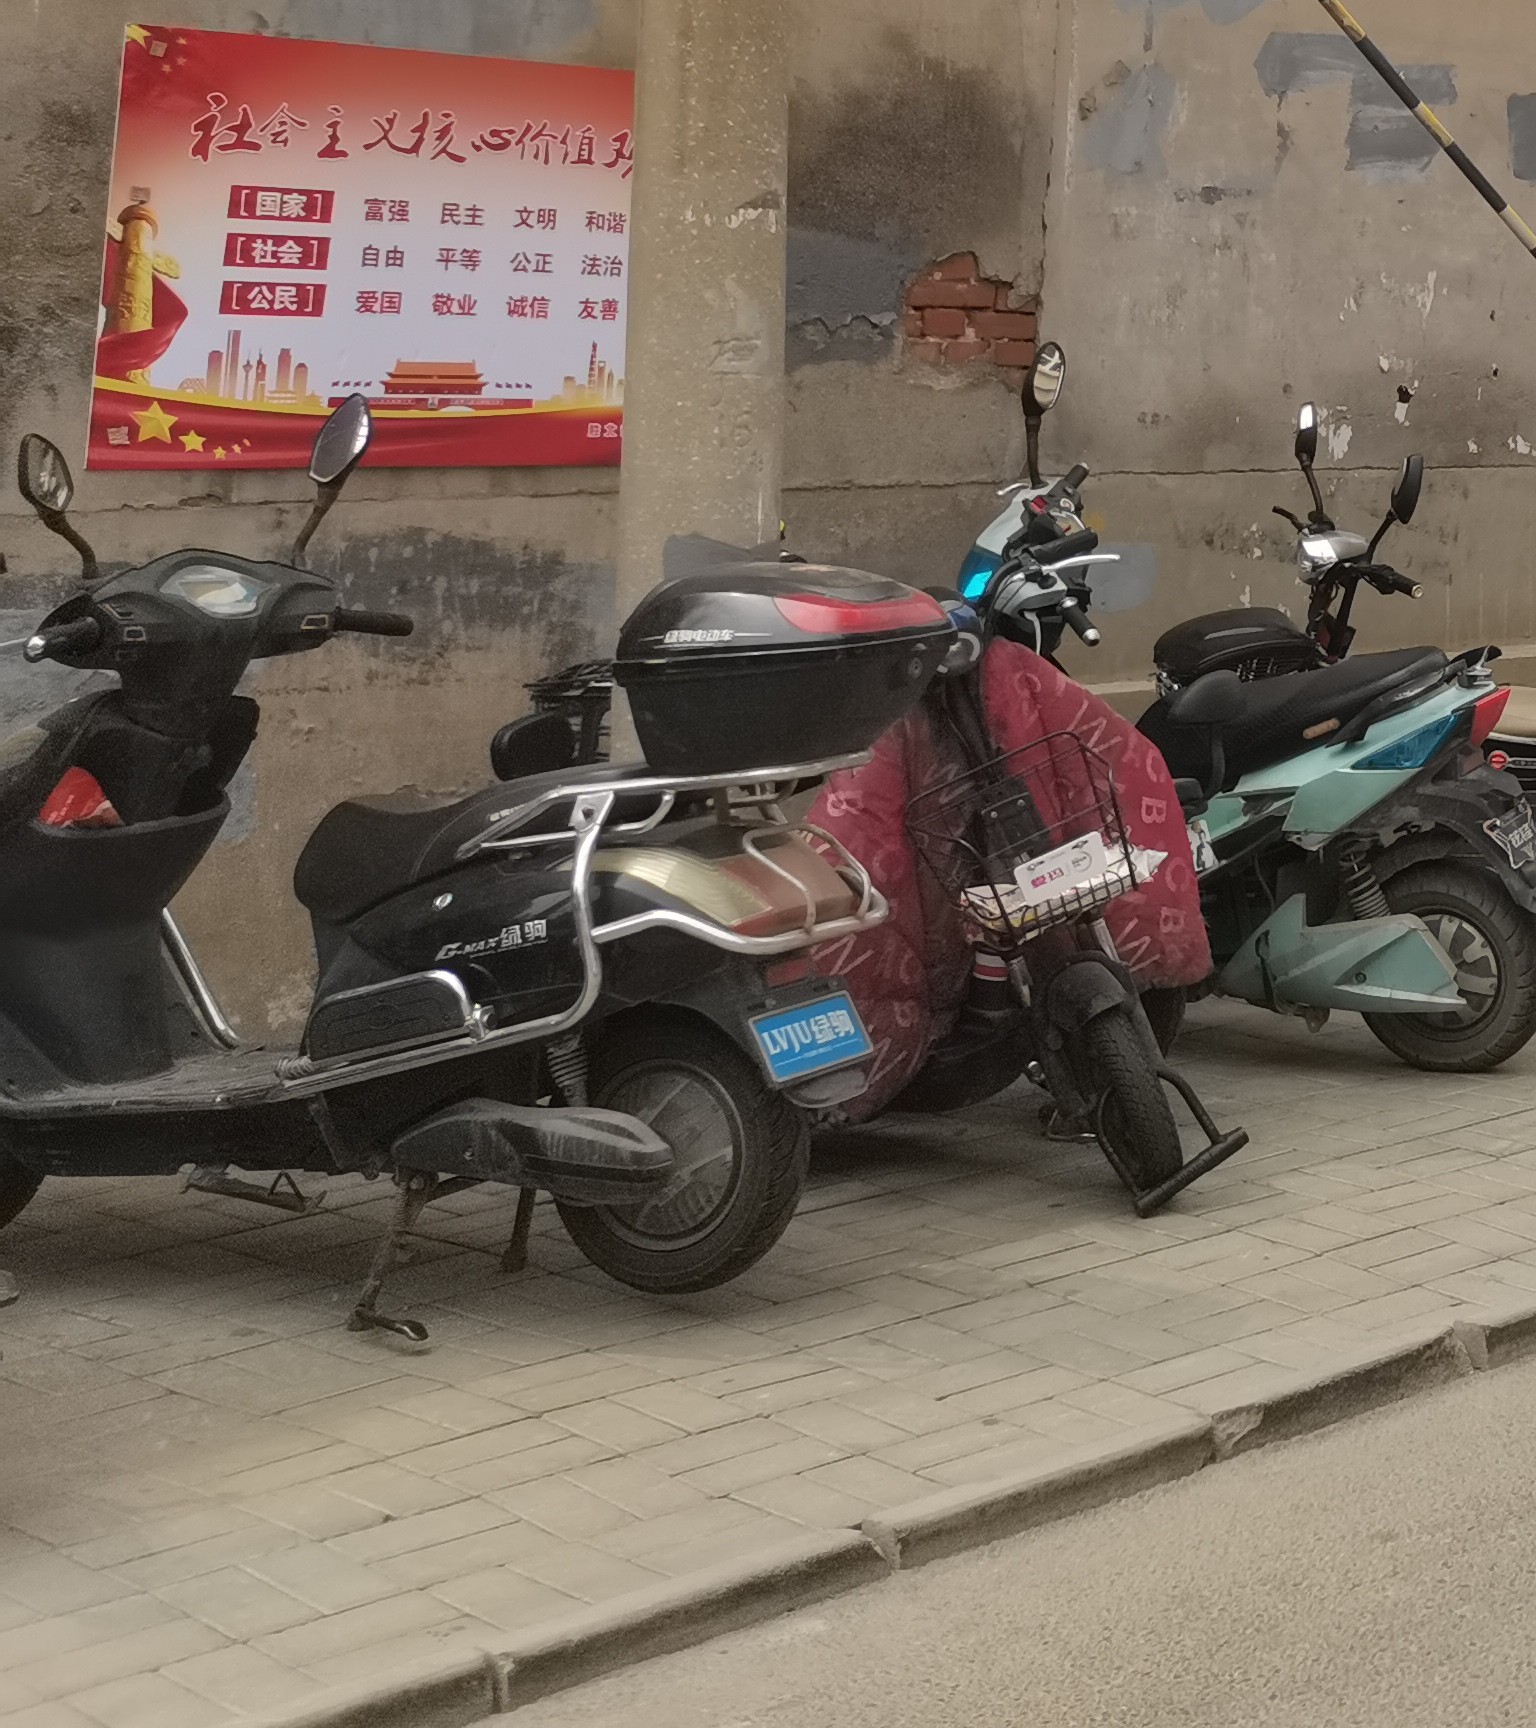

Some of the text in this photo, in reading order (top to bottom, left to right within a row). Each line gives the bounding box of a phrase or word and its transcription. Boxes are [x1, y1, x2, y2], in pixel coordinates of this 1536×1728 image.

[364, 198, 411, 223] 富强
[440, 202, 486, 227] 民主
[513, 206, 558, 231] 文明
[585, 208, 628, 235] 和谐
[361, 245, 405, 268] 自由
[436, 247, 483, 272] 平等
[510, 252, 555, 274] 公正
[580, 254, 624, 278] 法治
[355, 290, 403, 315] 爱国
[431, 292, 478, 317] 敬业
[506, 294, 551, 319] 诚信
[578, 296, 620, 322] 友善
